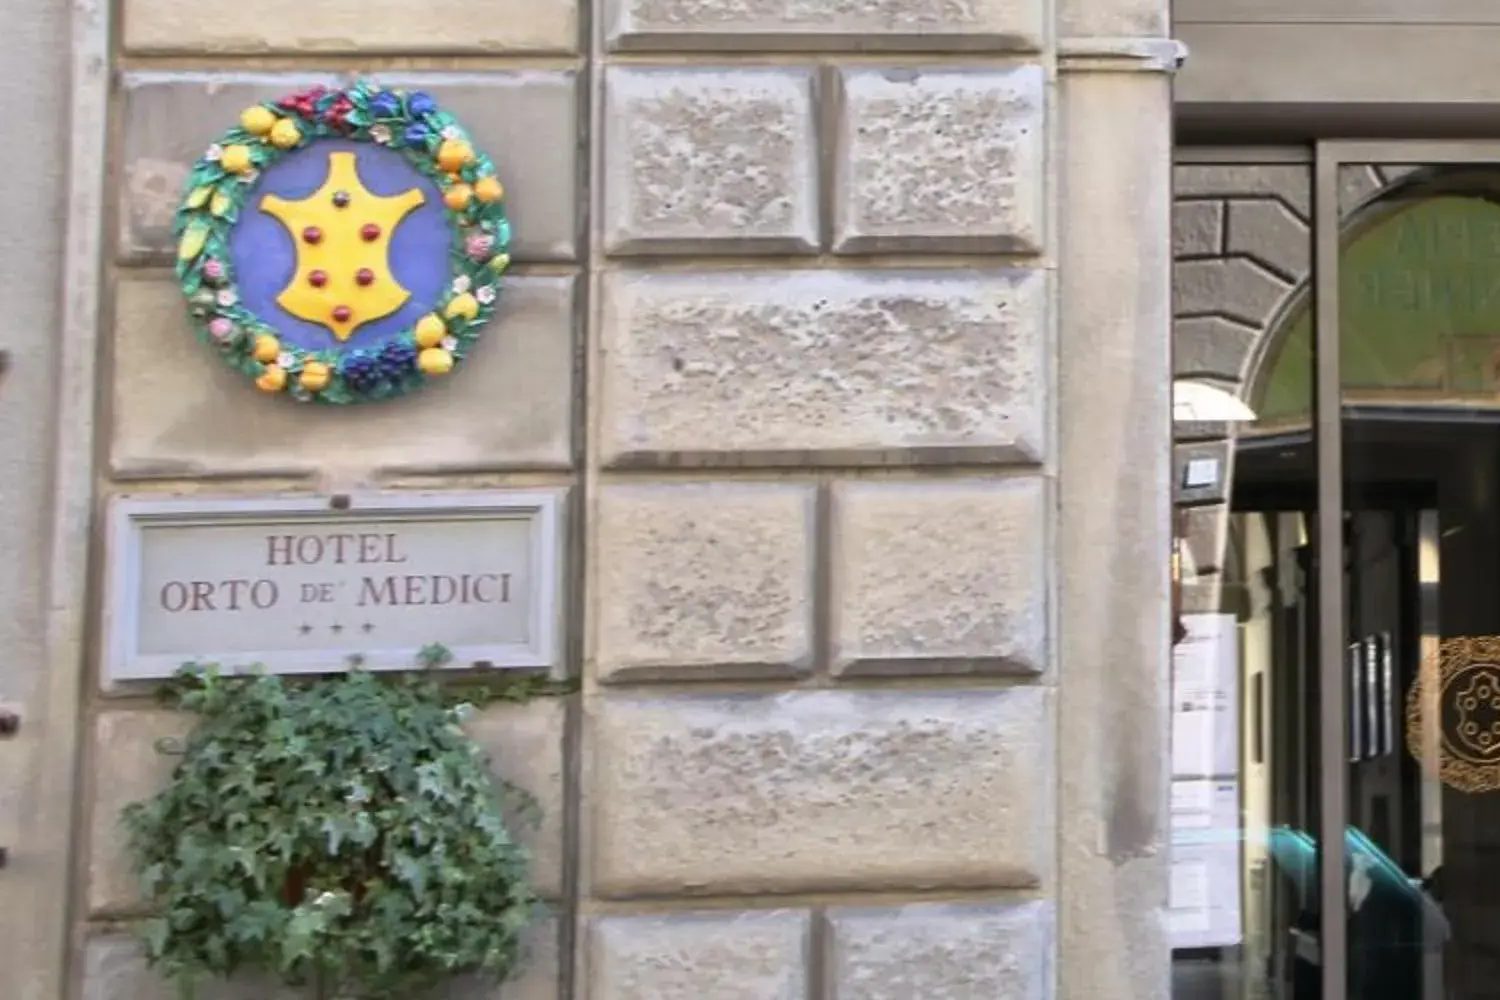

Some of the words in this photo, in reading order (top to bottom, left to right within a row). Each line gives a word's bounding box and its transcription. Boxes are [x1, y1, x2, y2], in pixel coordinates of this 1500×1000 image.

[265, 533, 408, 566] HOTEL
[160, 578, 280, 613] ORTO
[356, 572, 512, 607] MEDICI
